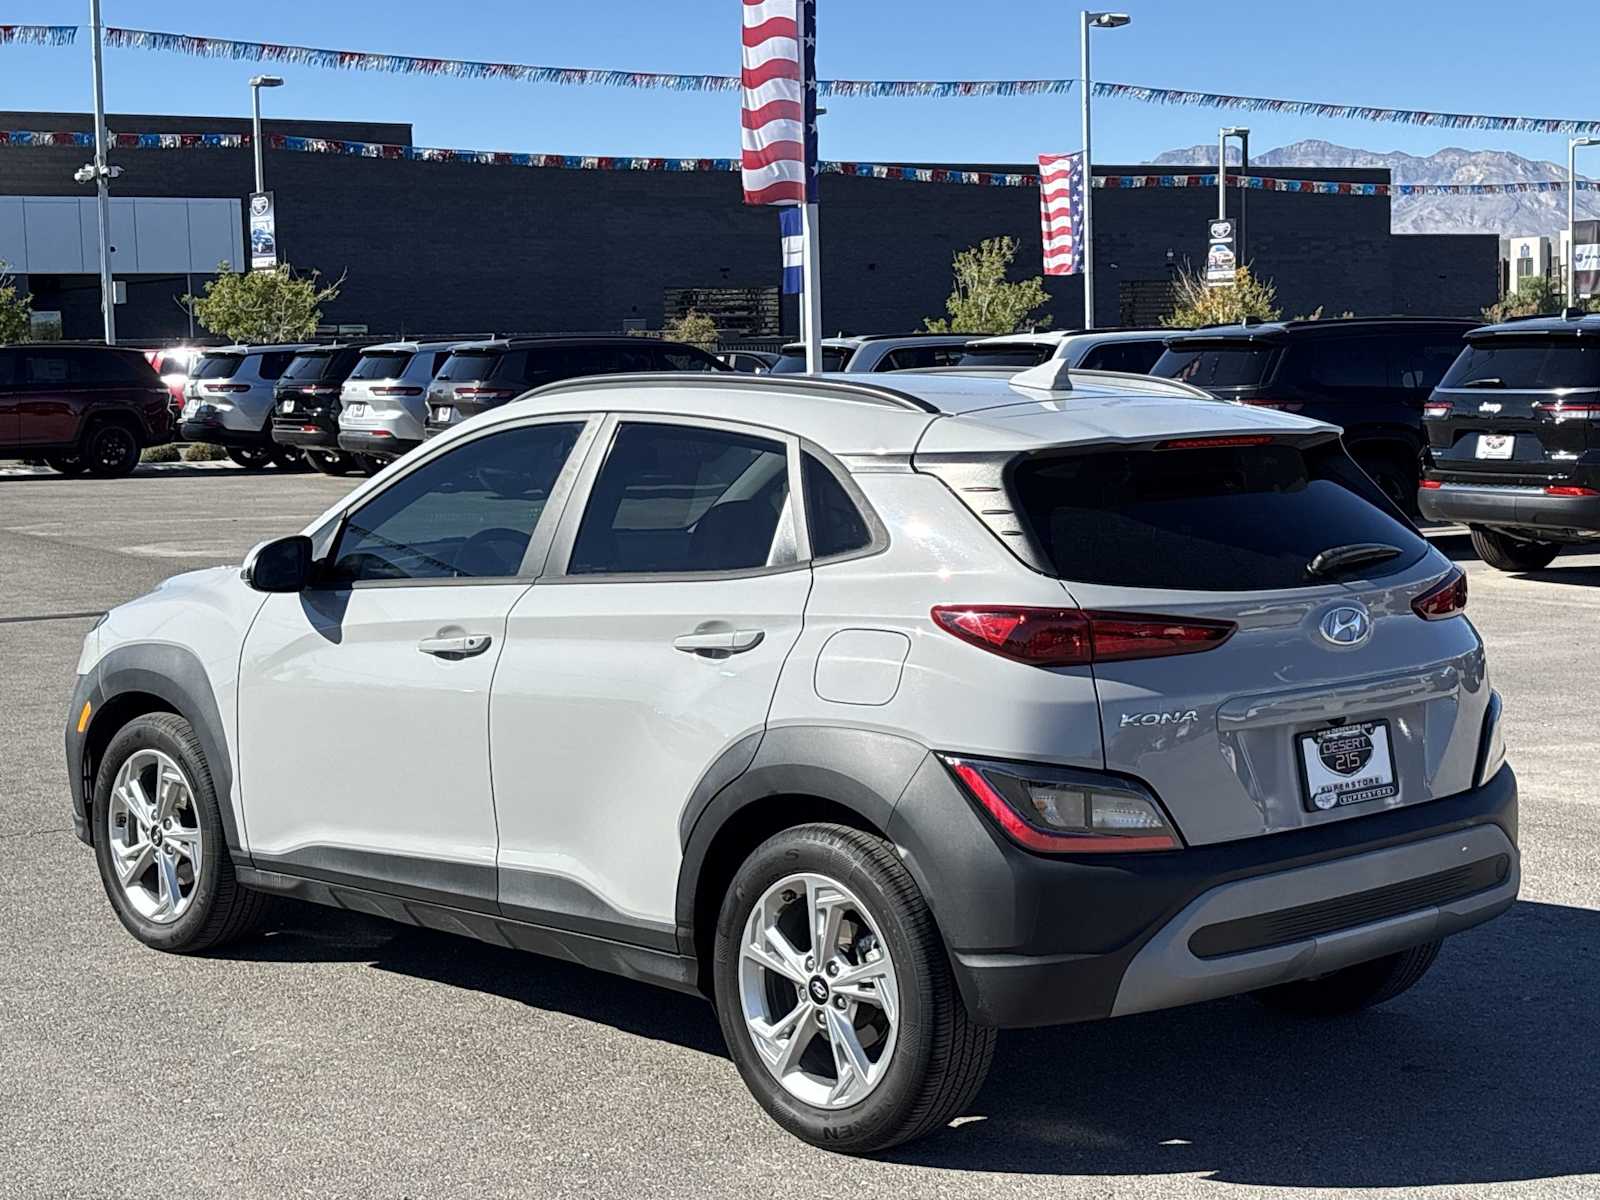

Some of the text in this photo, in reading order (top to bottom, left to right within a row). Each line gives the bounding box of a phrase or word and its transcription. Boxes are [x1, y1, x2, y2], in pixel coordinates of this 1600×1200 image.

[1120, 710, 1199, 728] KONA
[1322, 736, 1367, 754] DESERT
[1335, 752, 1361, 770] 215
